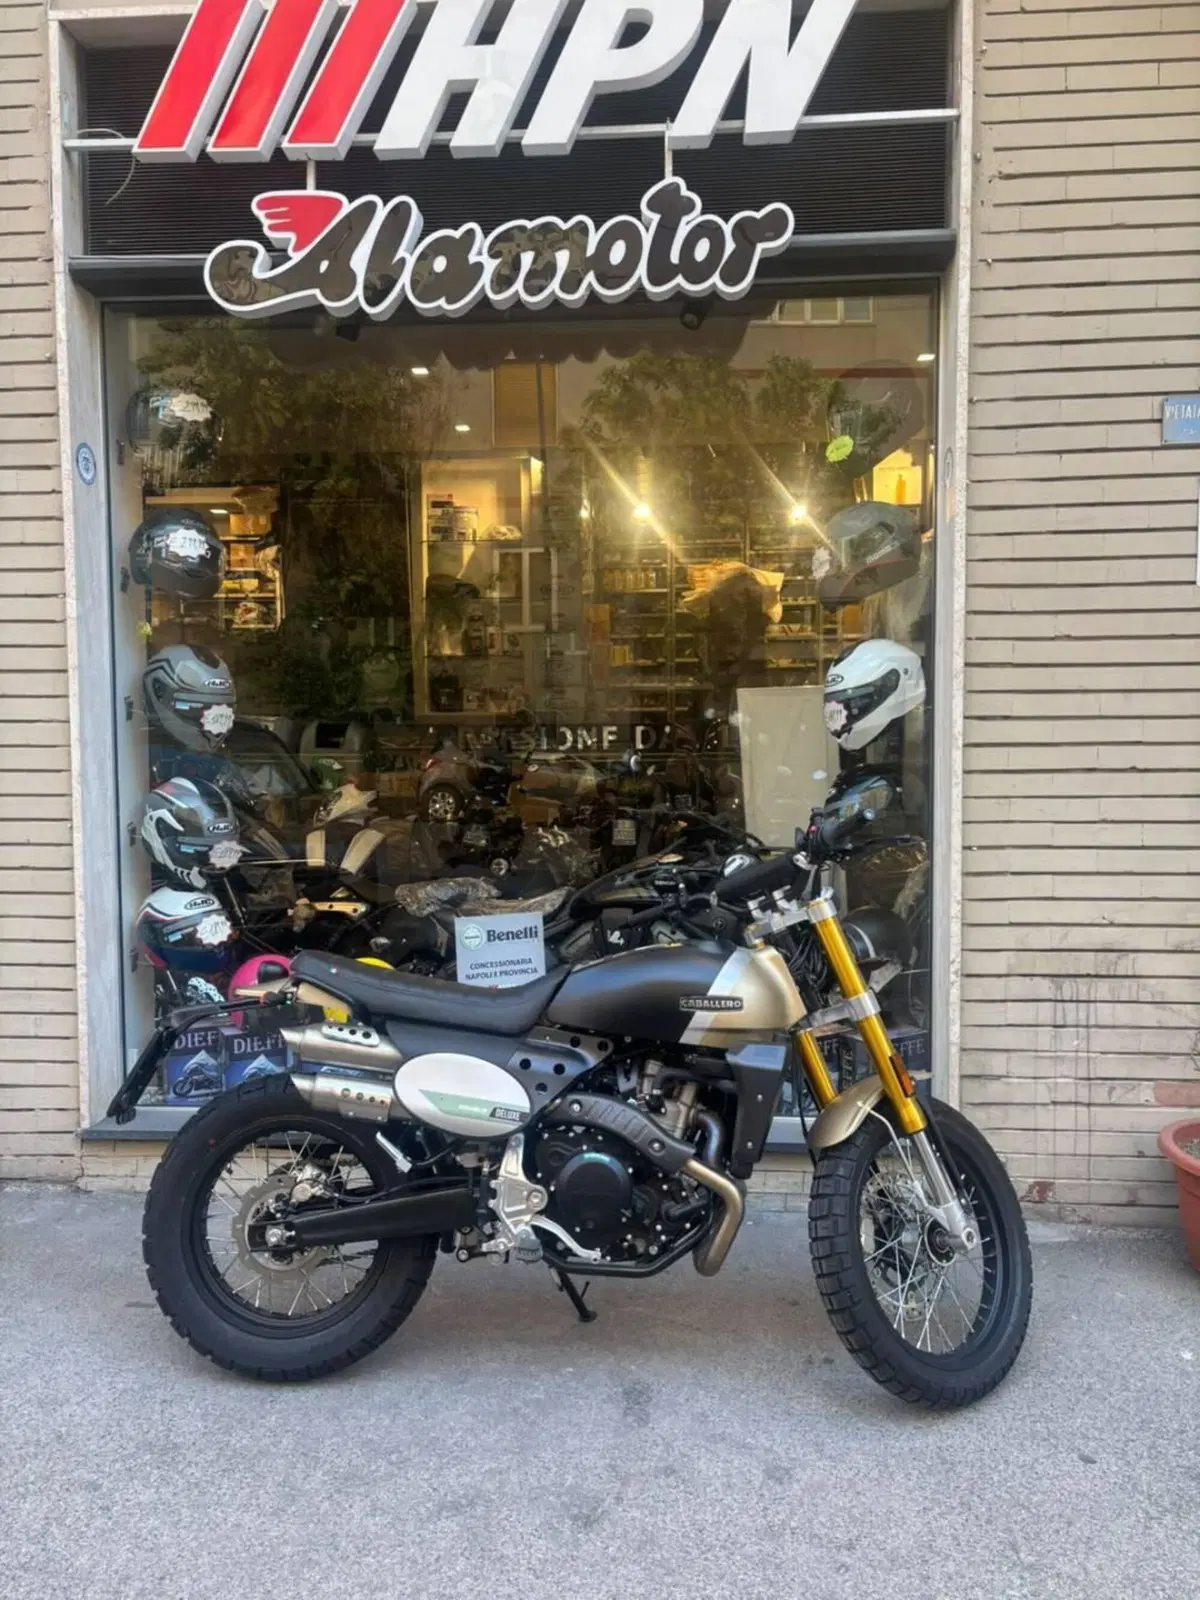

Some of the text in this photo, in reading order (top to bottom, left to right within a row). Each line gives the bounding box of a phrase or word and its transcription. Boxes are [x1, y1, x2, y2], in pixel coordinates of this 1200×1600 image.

[372, 0, 858, 160] HPN
[204, 177, 796, 320] Alamotor
[486, 925, 539, 943] Benelli
[469, 957, 533, 971] CONCESSIONARIA
[465, 971, 493, 981] NAPOLI
[499, 967, 538, 978] PROVINCIA
[681, 999, 741, 1009] CABALLERO
[896, 1037, 926, 1057] FFE
[495, 1107, 520, 1121] DELUXE
